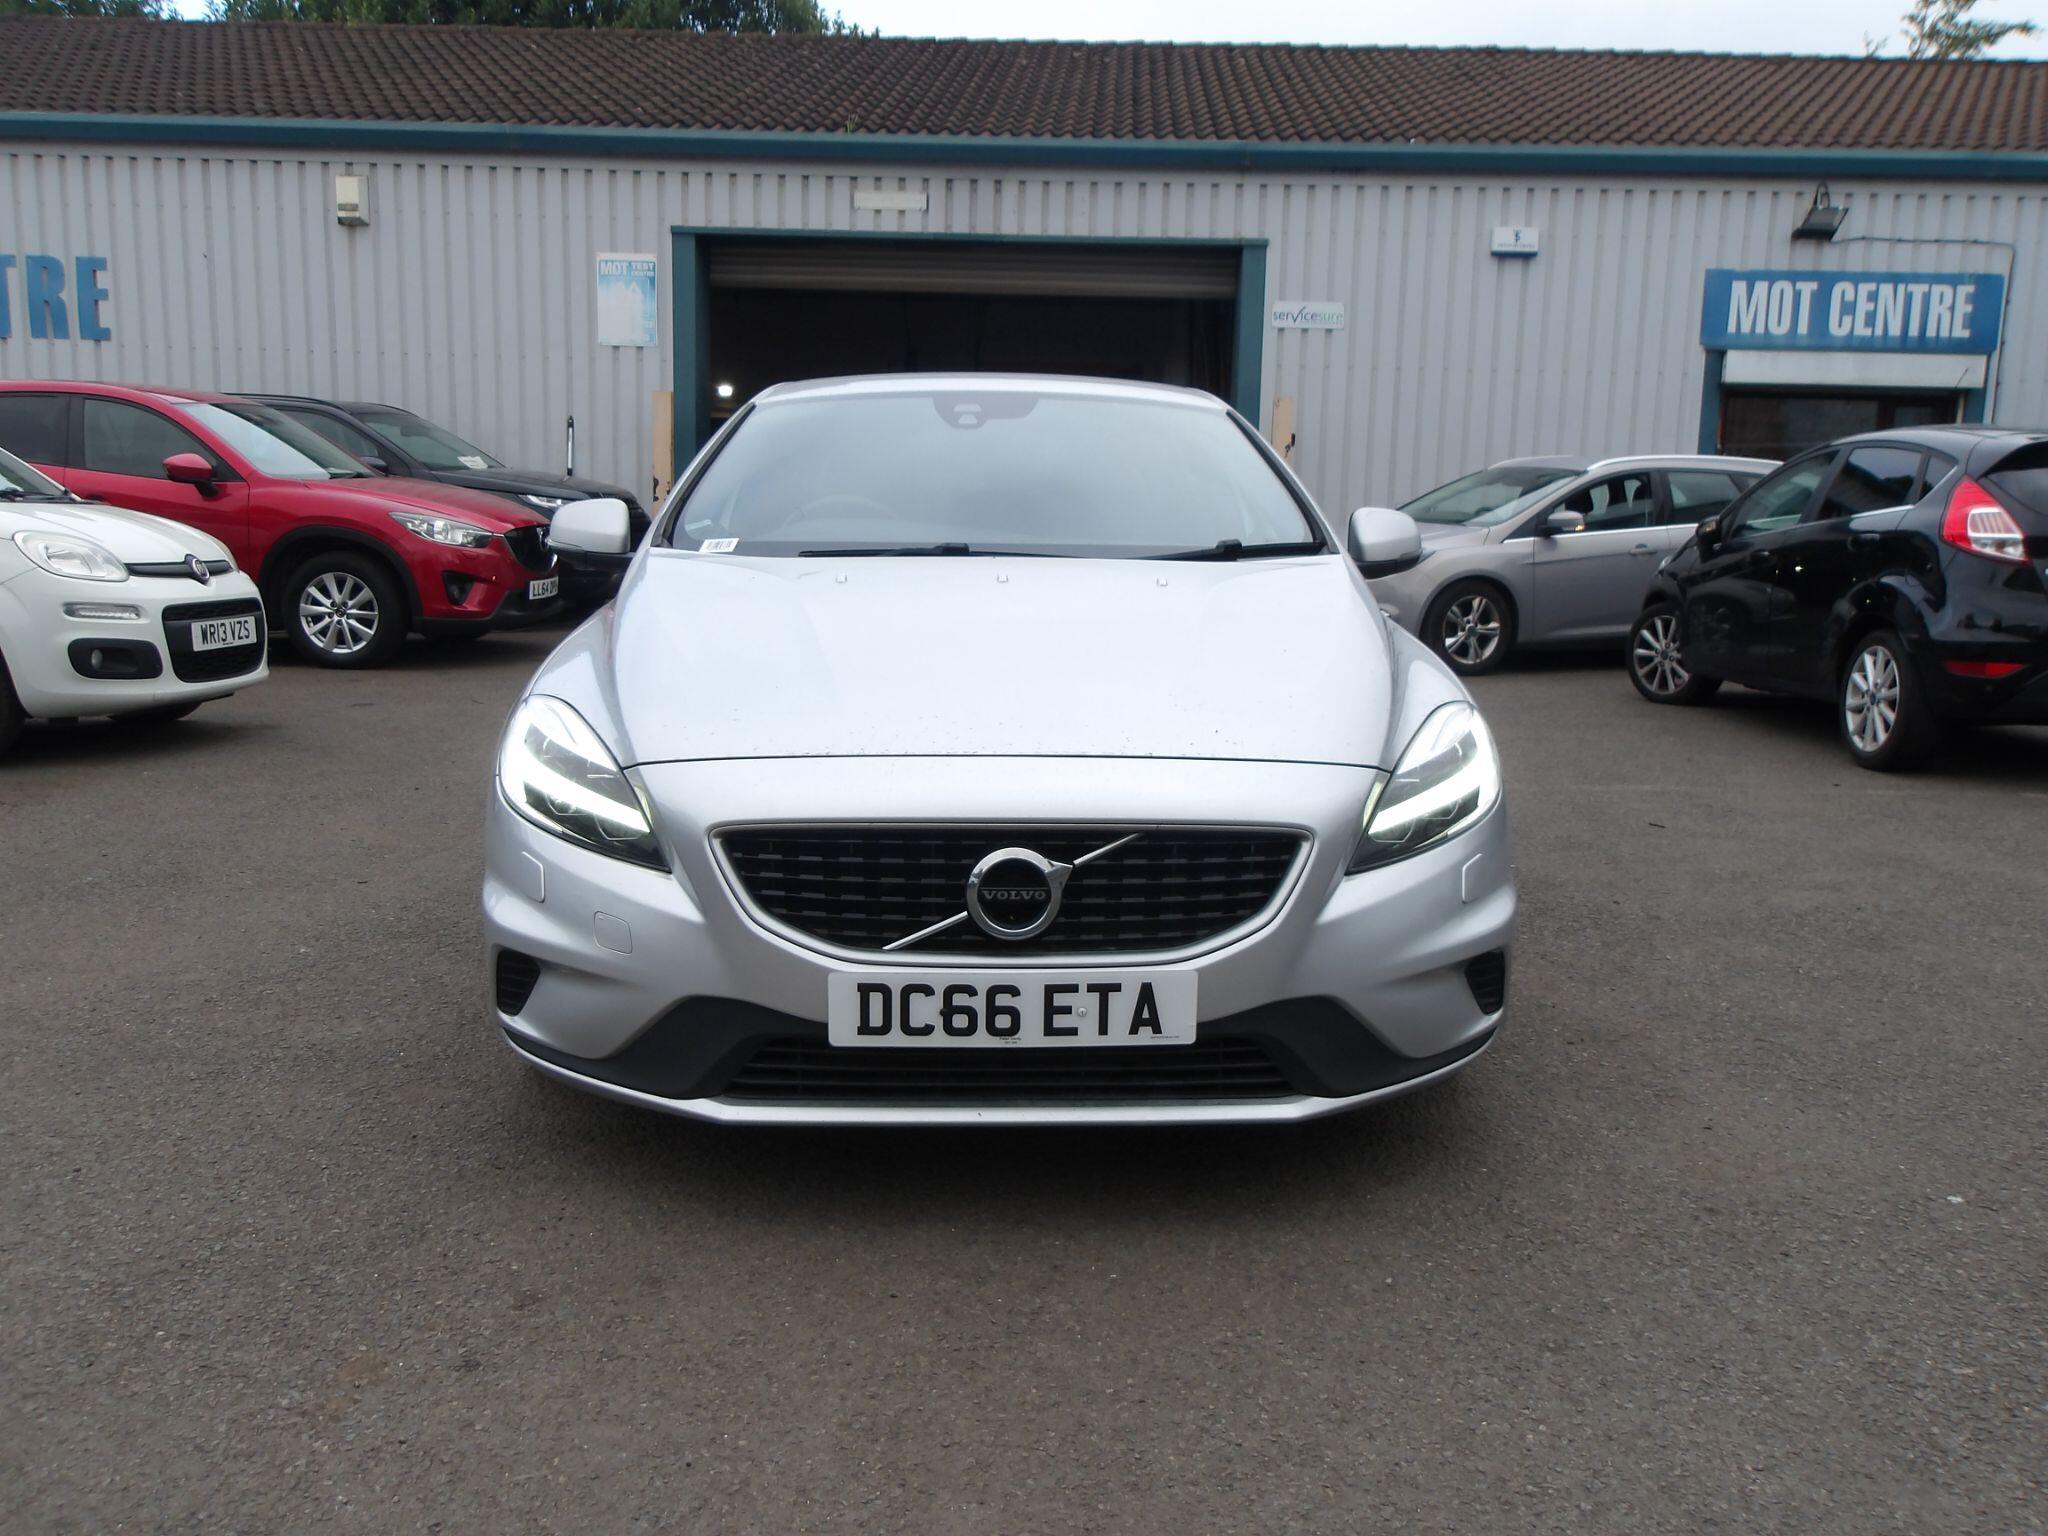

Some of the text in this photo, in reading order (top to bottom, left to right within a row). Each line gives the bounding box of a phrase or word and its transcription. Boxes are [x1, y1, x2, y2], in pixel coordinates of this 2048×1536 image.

[600, 261, 655, 275] MOT TEST
[1727, 280, 1976, 338] MOT CENTRE
[532, 581, 549, 597] LL64
[200, 620, 250, 646] WR13 VZS
[982, 890, 1046, 900] VOLVO
[857, 982, 1162, 1037] DC66 ETA
